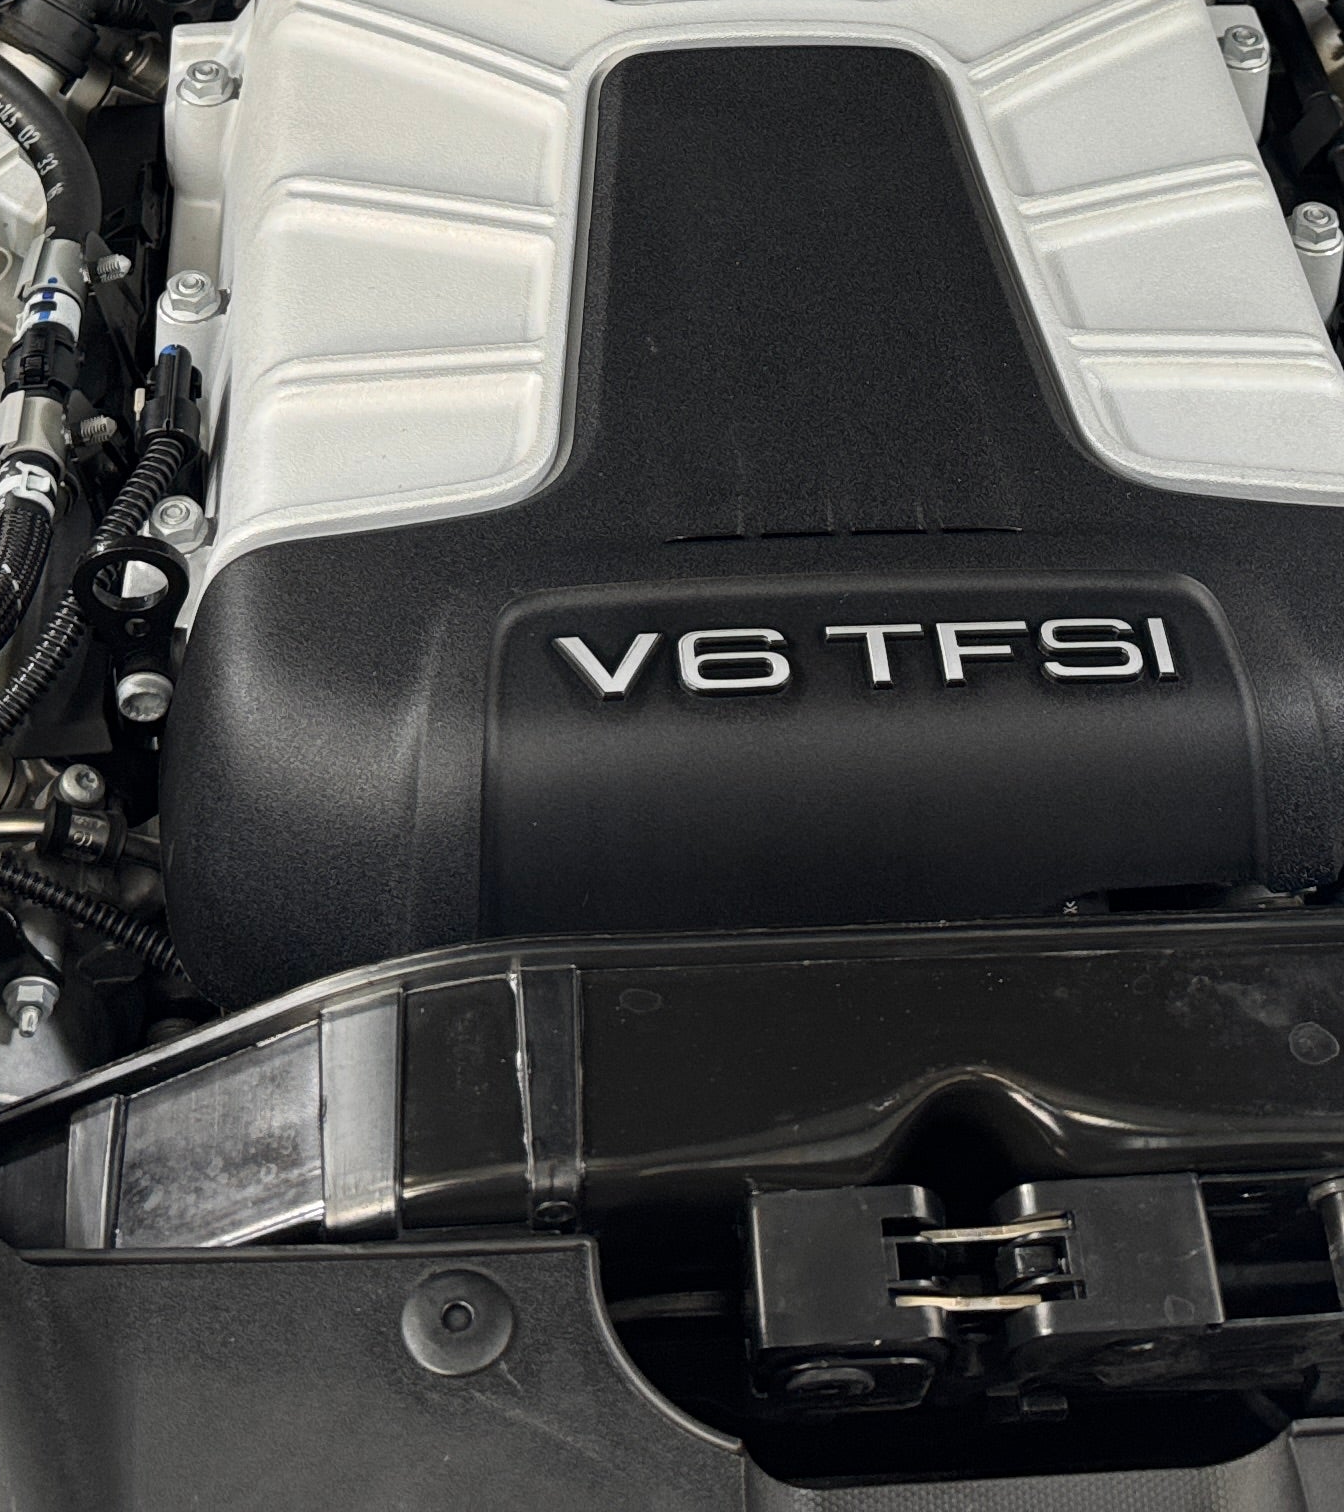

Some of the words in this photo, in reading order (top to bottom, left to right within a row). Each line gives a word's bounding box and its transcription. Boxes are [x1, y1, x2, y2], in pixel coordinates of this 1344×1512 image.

[17, 124, 42, 150] 02
[37, 153, 60, 177] 33
[552, 626, 792, 701] V6
[824, 616, 1182, 689] TFSI
